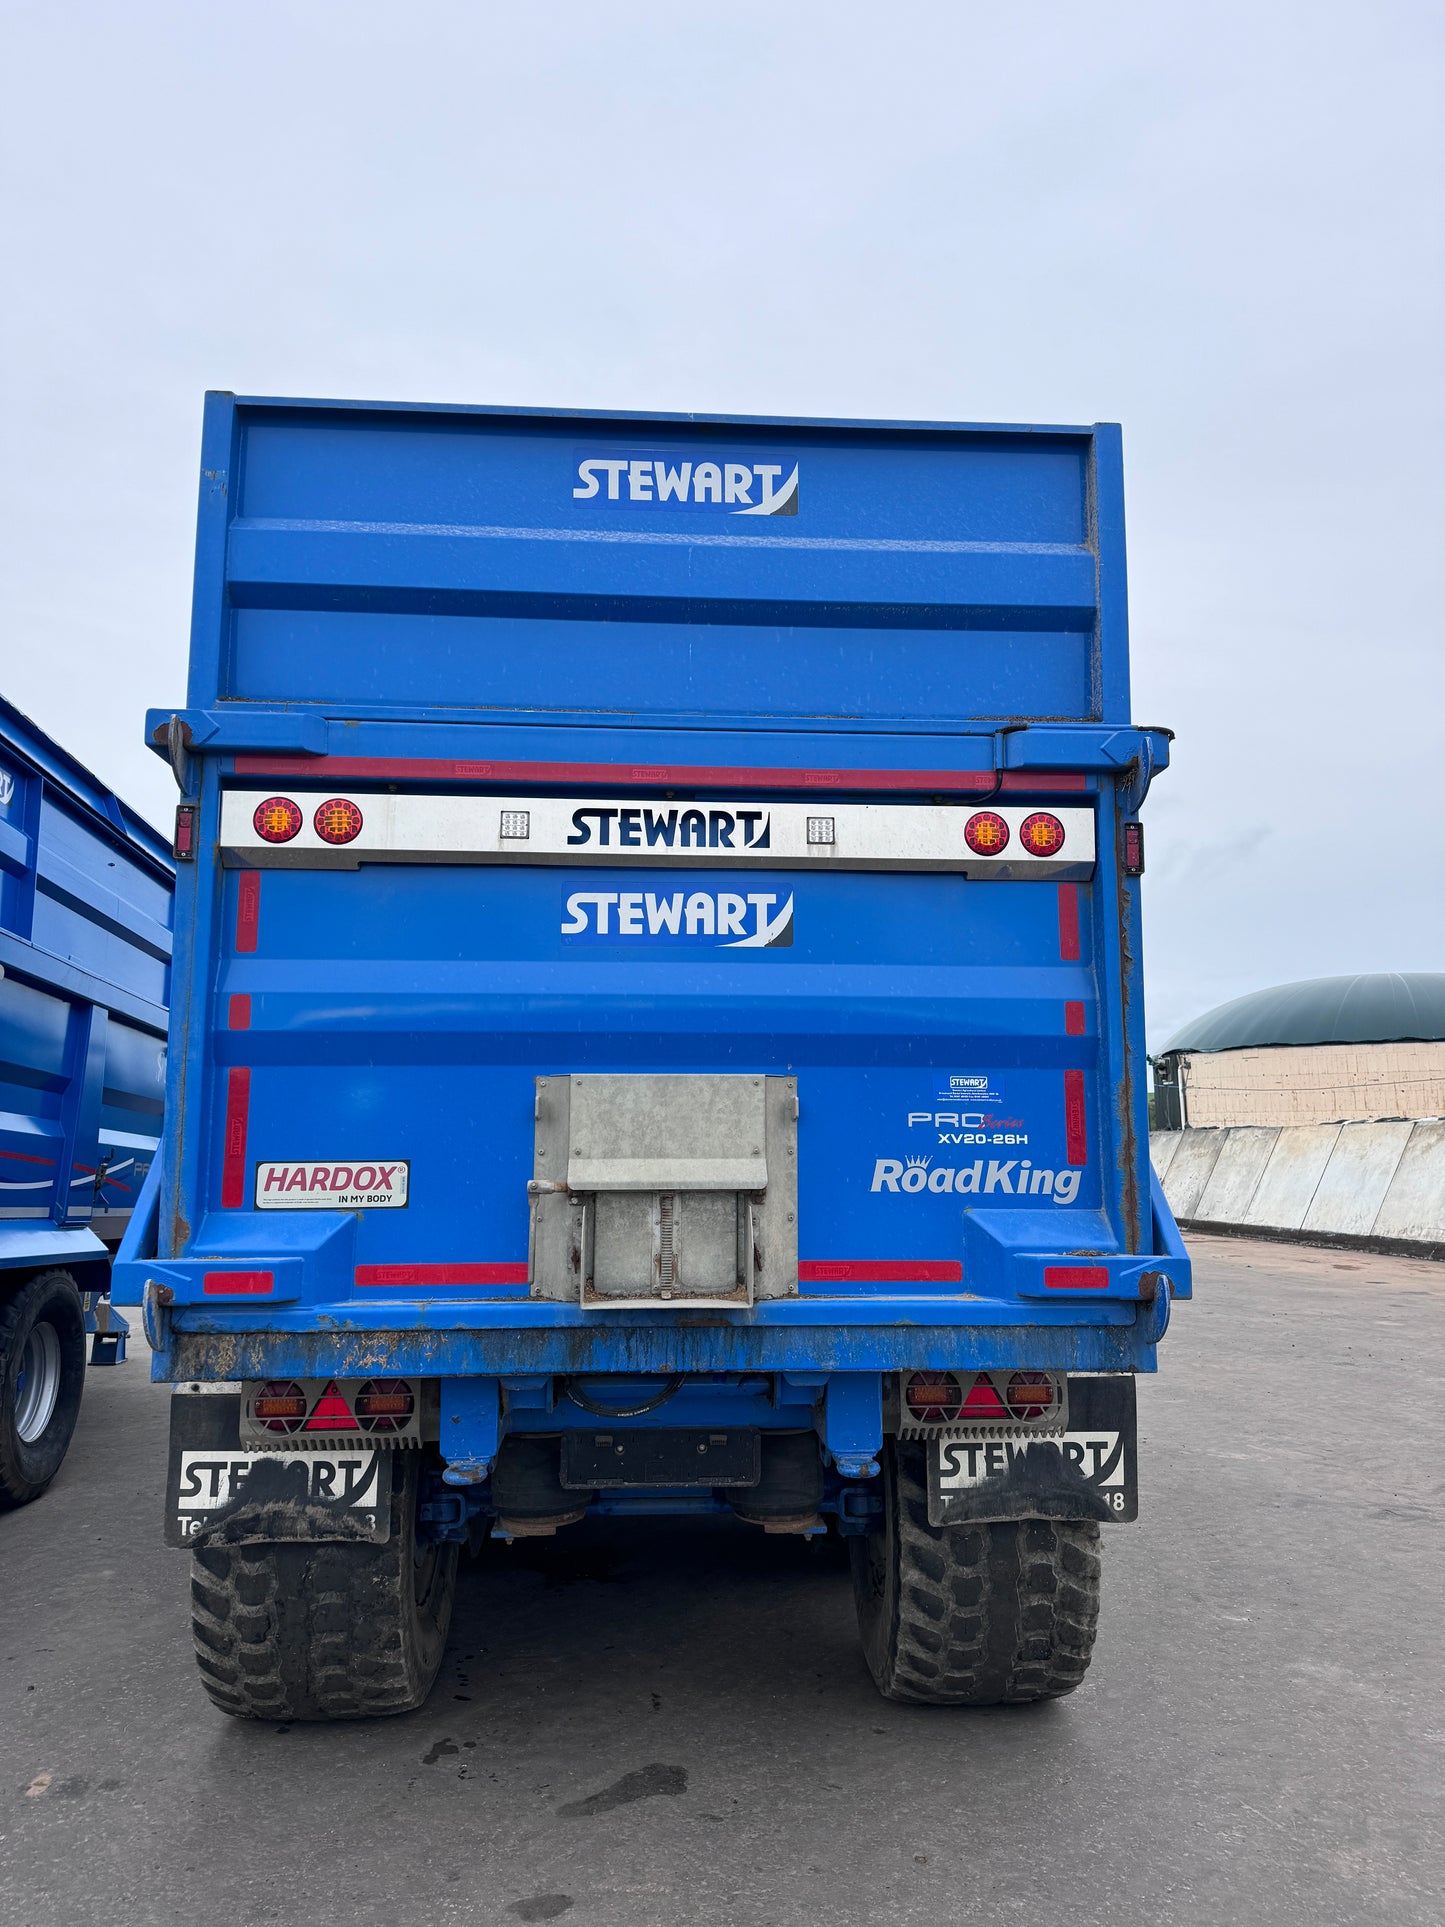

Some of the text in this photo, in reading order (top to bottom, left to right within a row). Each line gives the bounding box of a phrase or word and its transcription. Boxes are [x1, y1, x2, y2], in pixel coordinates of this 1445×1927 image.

[573, 459, 799, 516] STEWART
[567, 807, 770, 848] STEWART
[561, 891, 793, 947] STEWART
[951, 1078, 987, 1088] STEWART
[908, 1112, 984, 1128] PRO
[938, 1133, 1028, 1145] XV20-26H
[263, 1166, 398, 1192] HARDOX
[870, 1157, 1082, 1205] RoadKing
[338, 1194, 393, 1203] IN MY BODY
